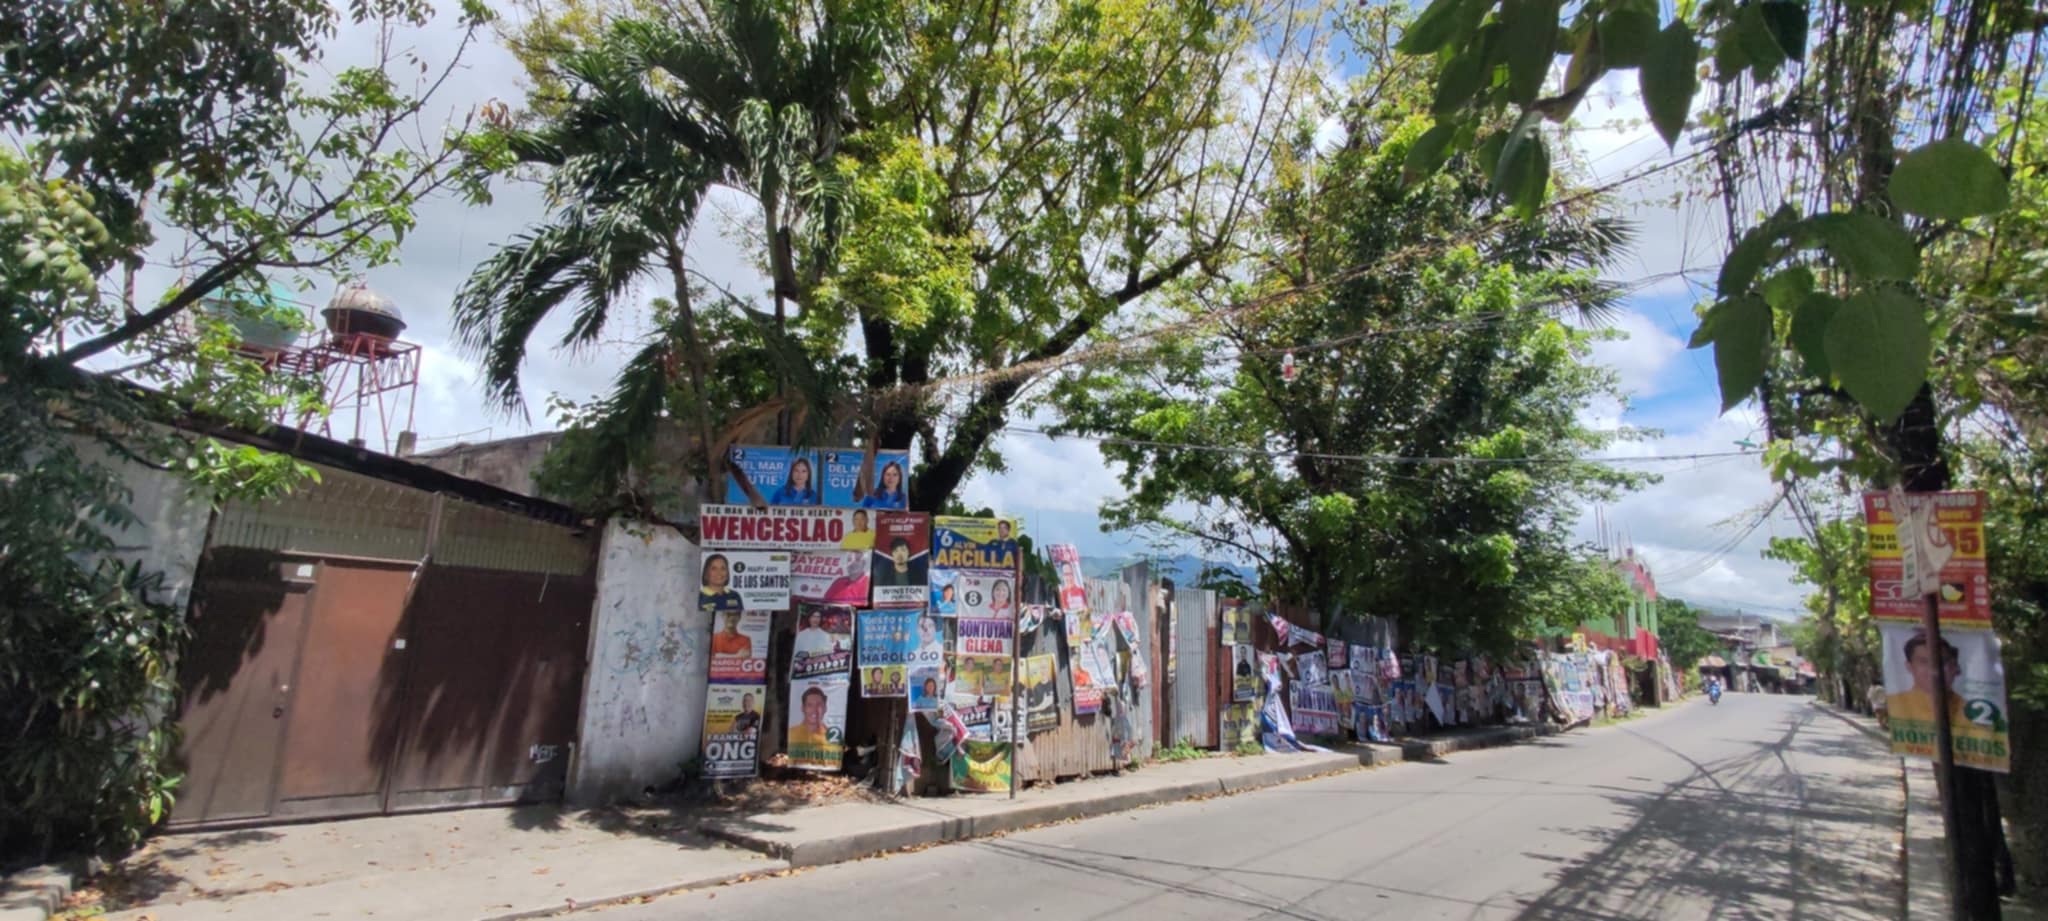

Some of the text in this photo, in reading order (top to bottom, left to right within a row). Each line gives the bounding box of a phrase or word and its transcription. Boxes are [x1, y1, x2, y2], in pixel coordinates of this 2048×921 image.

[735, 450, 743, 459] 2
[828, 453, 836, 462] 2
[758, 462, 784, 471] MAR
[829, 465, 849, 474] DEL
[706, 506, 721, 514] BIG
[724, 507, 743, 515] MAN
[772, 508, 787, 516] THE
[808, 509, 833, 517] HEART
[702, 516, 844, 542] WENCESLAO
[791, 555, 841, 567] JAYPEE
[935, 548, 1015, 568] ARCILLA
[733, 575, 789, 588] DE LOS SANTOS
[969, 593, 978, 604] 8
[959, 620, 1012, 639] BONTUYAN
[966, 639, 1003, 654] GLENA
[862, 651, 939, 662] HAROLD GO
[742, 659, 766, 672] GO
[1971, 702, 1993, 724] 2
[829, 728, 839, 742] 2
[705, 741, 756, 760] ONG
